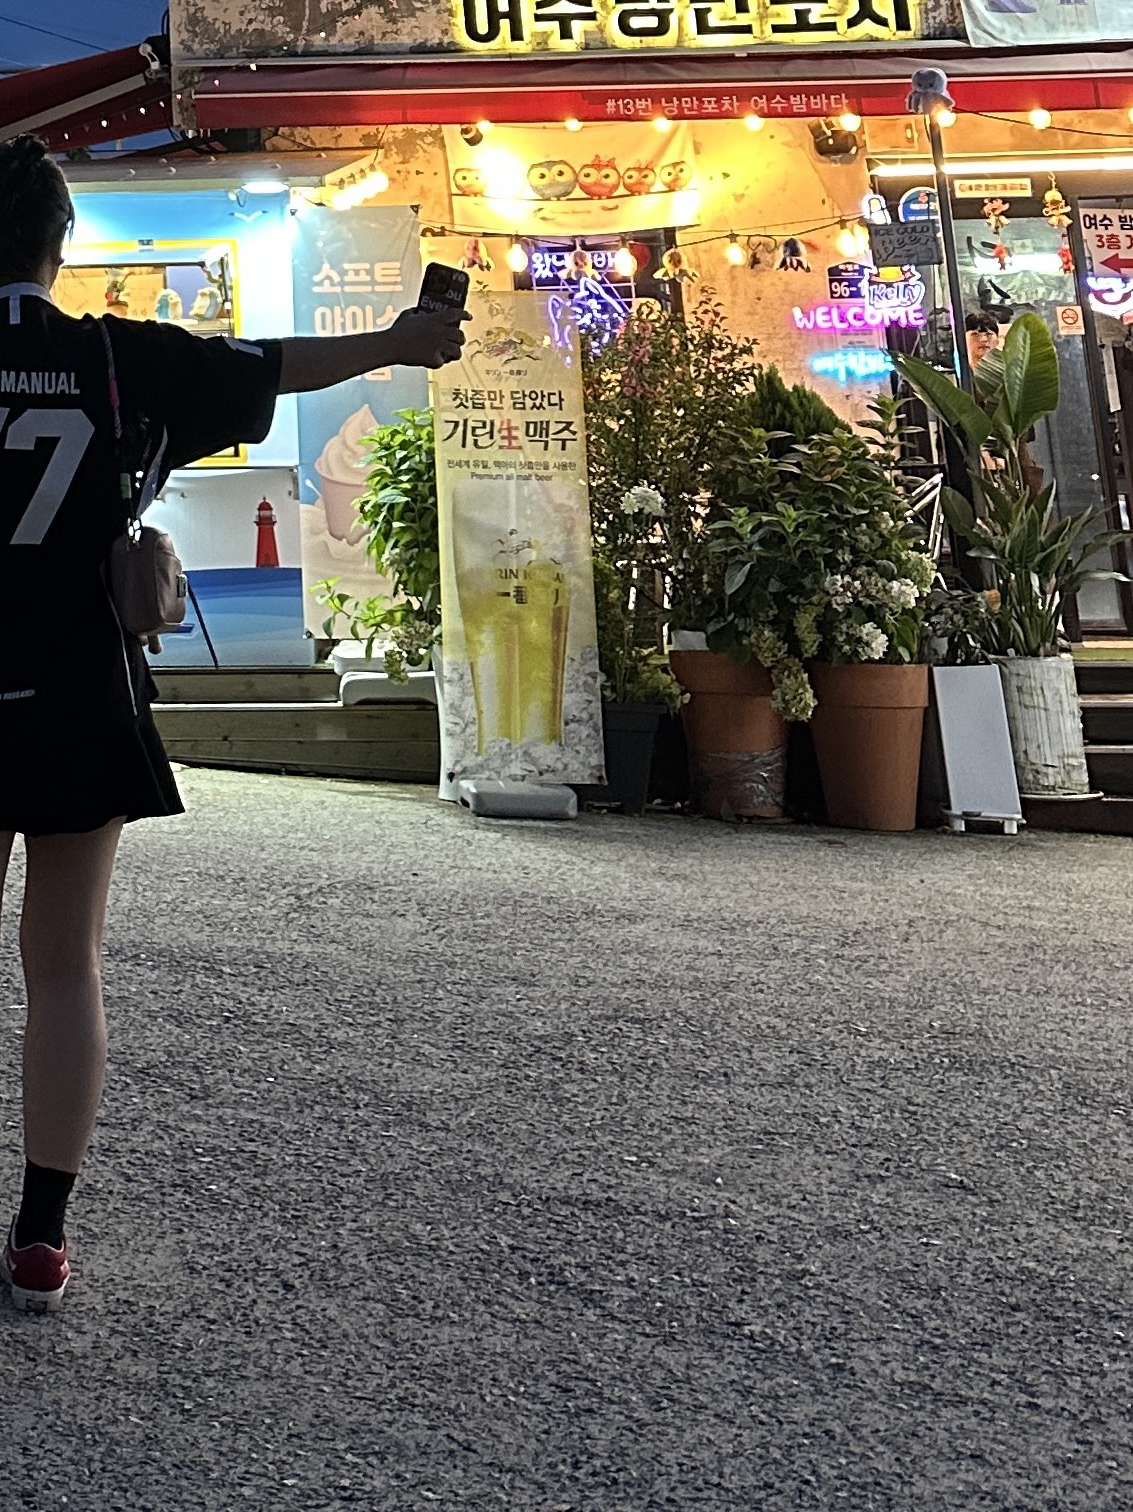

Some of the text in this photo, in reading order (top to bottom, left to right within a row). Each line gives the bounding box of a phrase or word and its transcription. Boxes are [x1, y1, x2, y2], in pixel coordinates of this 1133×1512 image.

[606, 93, 849, 116] #13번 낭만포차 여수밤바다
[896, 225, 930, 235] COLD
[1082, 214, 1115, 231] 여수
[1095, 234, 1122, 249] 3층
[312, 261, 404, 293] 소프트
[870, 284, 923, 307] Kelly
[792, 305, 927, 329] WELCOME
[452, 387, 565, 411] 첫즙만 담았다
